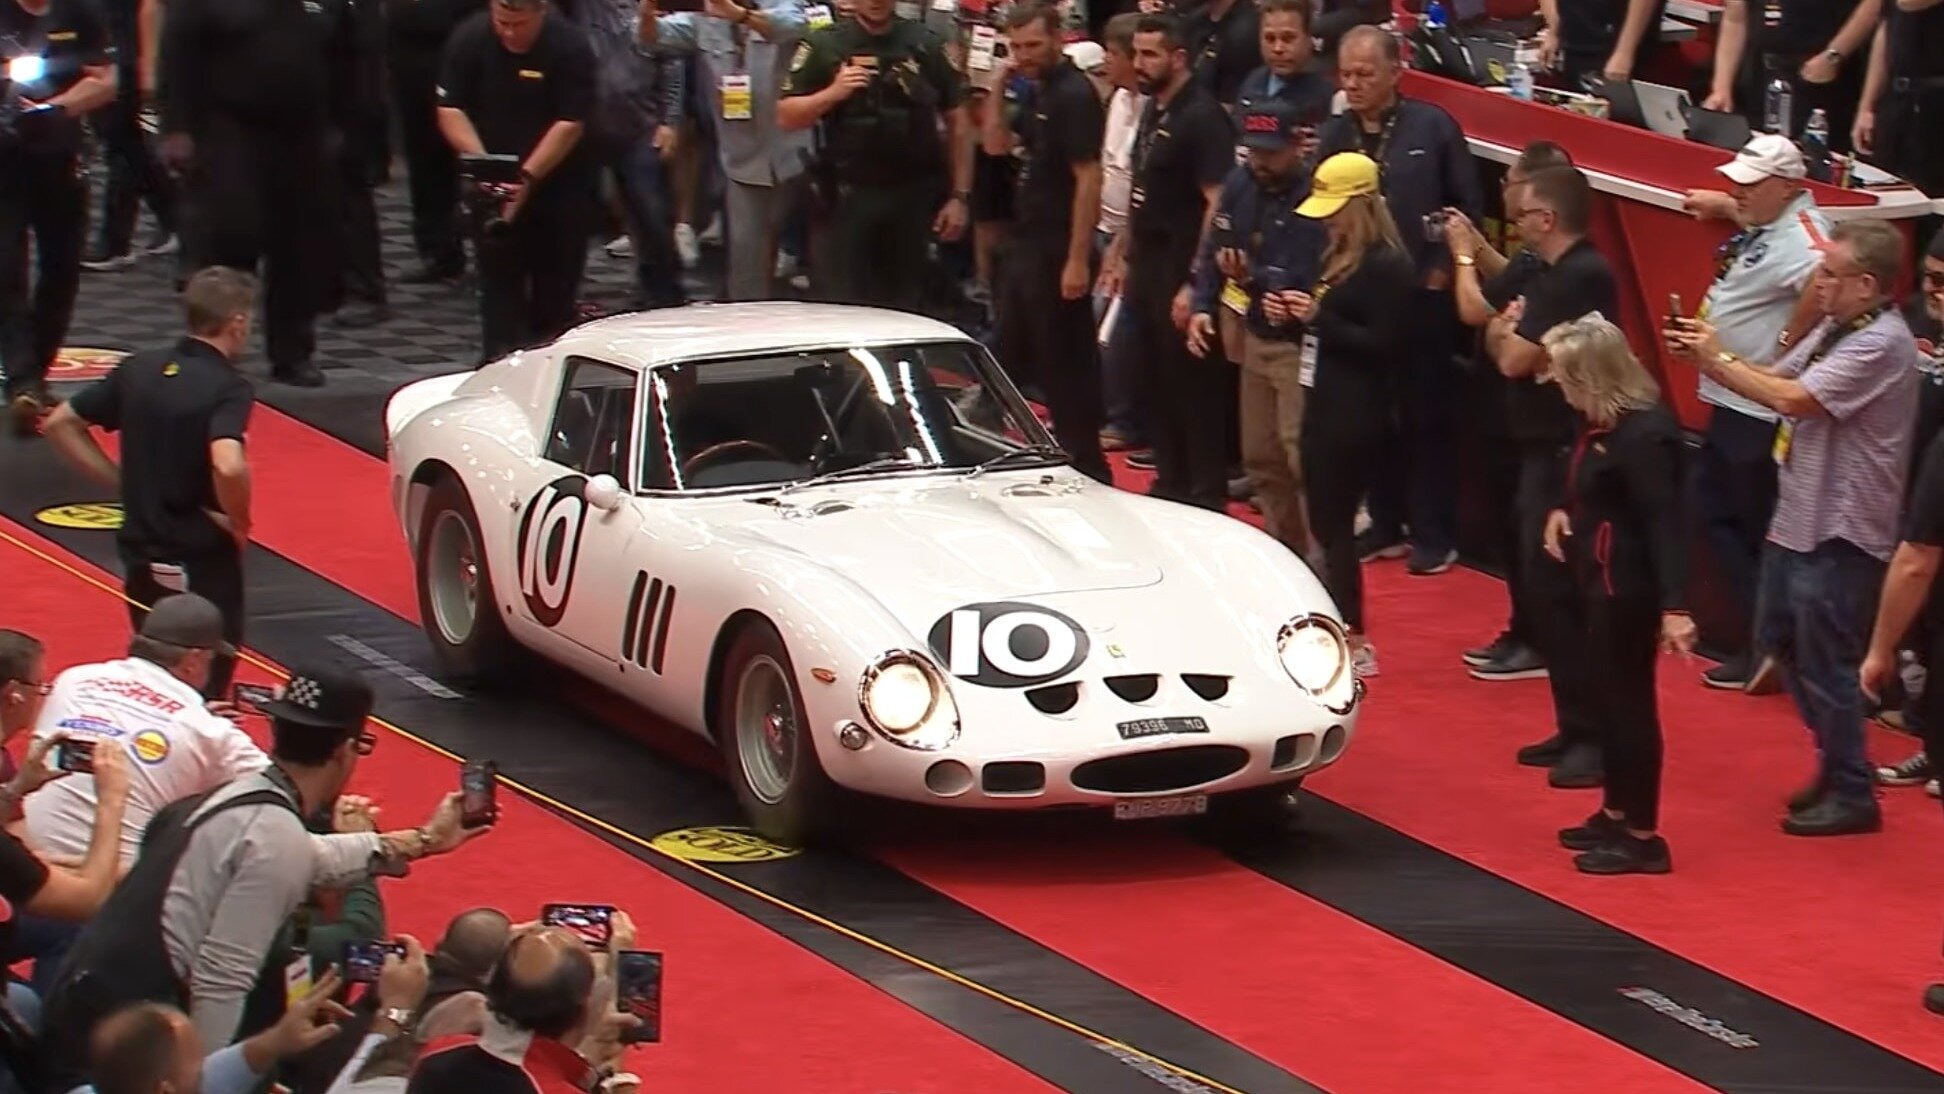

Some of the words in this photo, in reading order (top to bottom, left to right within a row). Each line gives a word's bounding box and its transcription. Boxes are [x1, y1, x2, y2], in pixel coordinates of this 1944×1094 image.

[523, 485, 582, 609] 10
[950, 610, 1076, 677] 10
[1121, 720, 1168, 736] 79396
